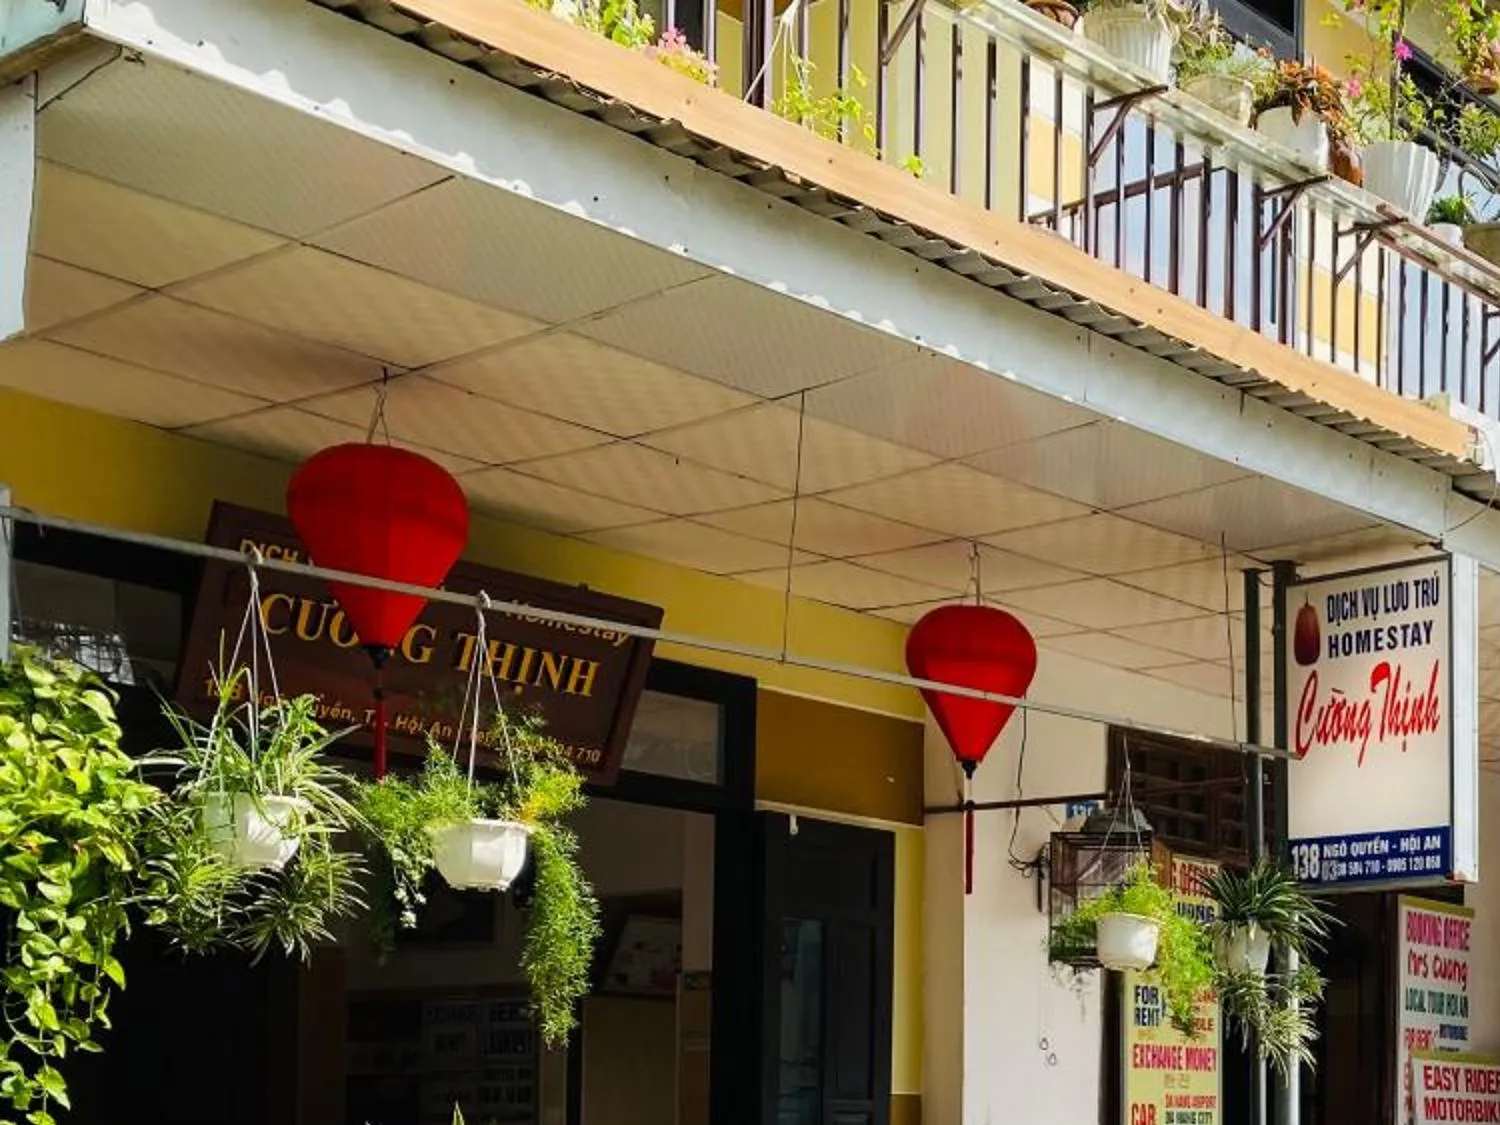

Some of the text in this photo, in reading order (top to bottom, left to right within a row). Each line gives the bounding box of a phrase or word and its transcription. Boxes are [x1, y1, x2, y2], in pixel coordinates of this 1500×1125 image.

[1327, 588, 1359, 627] DỊCH
[1361, 585, 1379, 622] VỤ
[260, 593, 600, 697] CƯG THỊNH
[1328, 620, 1434, 659] HOMESTAY
[1295, 658, 1440, 769] Cường Thịnh
[1291, 843, 1320, 880] 138
[1135, 985, 1159, 1005] FOR
[1135, 1007, 1159, 1027] RENT
[1133, 1043, 1217, 1073] EXCHANGE MONEY
[1423, 1065, 1460, 1092] EASY
